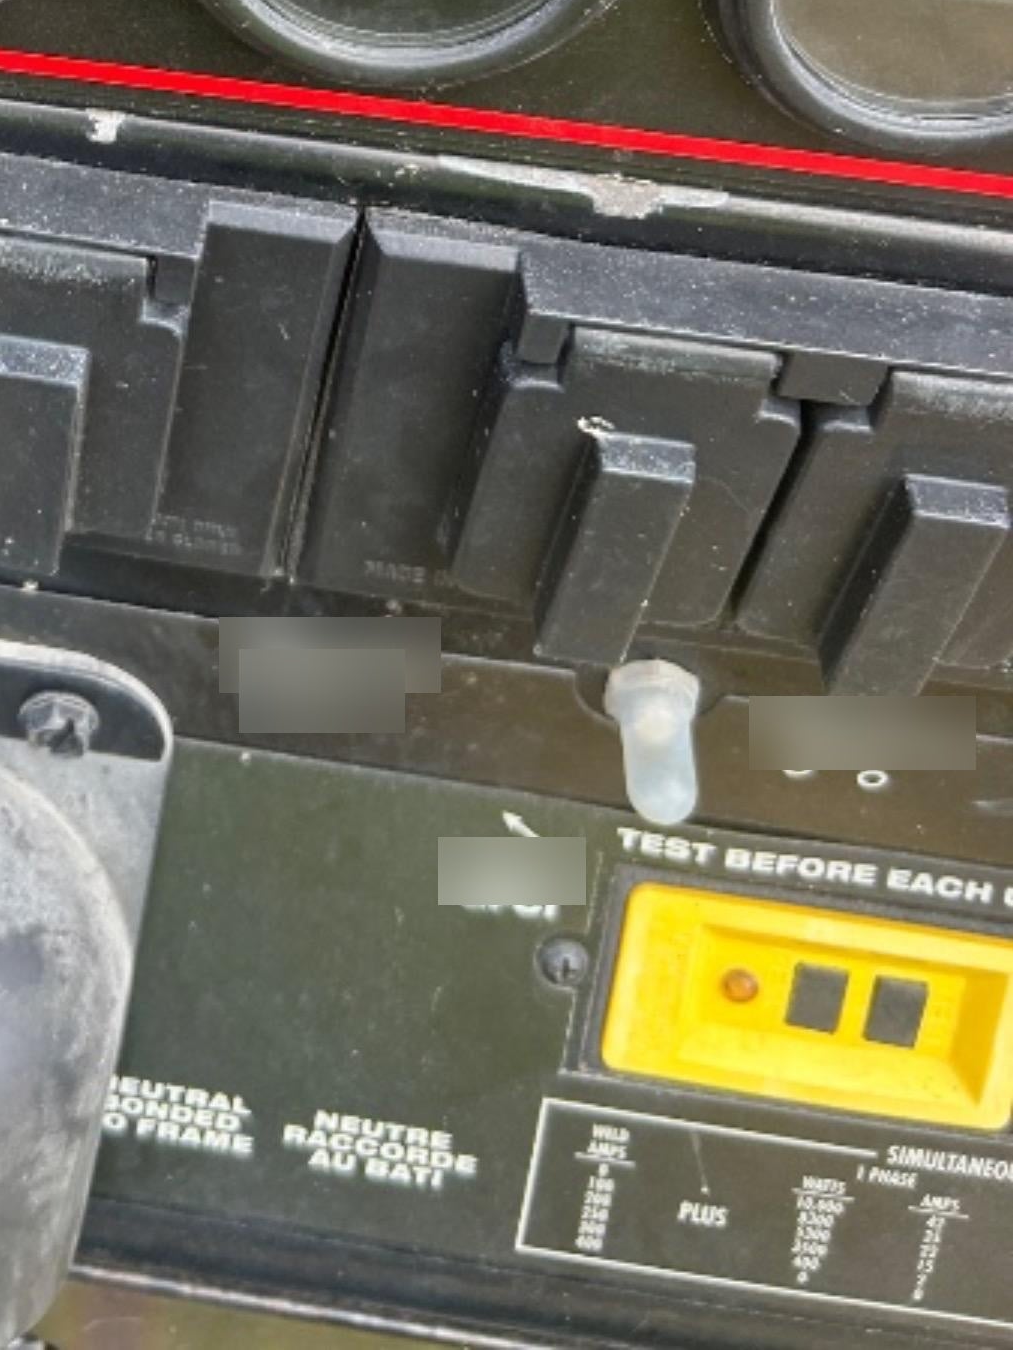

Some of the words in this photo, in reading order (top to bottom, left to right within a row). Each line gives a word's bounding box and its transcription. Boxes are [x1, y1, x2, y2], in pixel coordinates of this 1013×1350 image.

[617, 826, 716, 865] TEST
[724, 847, 878, 885] BEFORE
[887, 866, 994, 904] EACH
[136, 1117, 255, 1156] FRAME
[282, 1123, 479, 1176] RACCORDE
[314, 1109, 454, 1150] NEUTRE
[307, 1148, 357, 1174] AU
[364, 1157, 445, 1191] BATI
[868, 1166, 918, 1189] PHASE
[677, 1199, 728, 1229] PLUS
